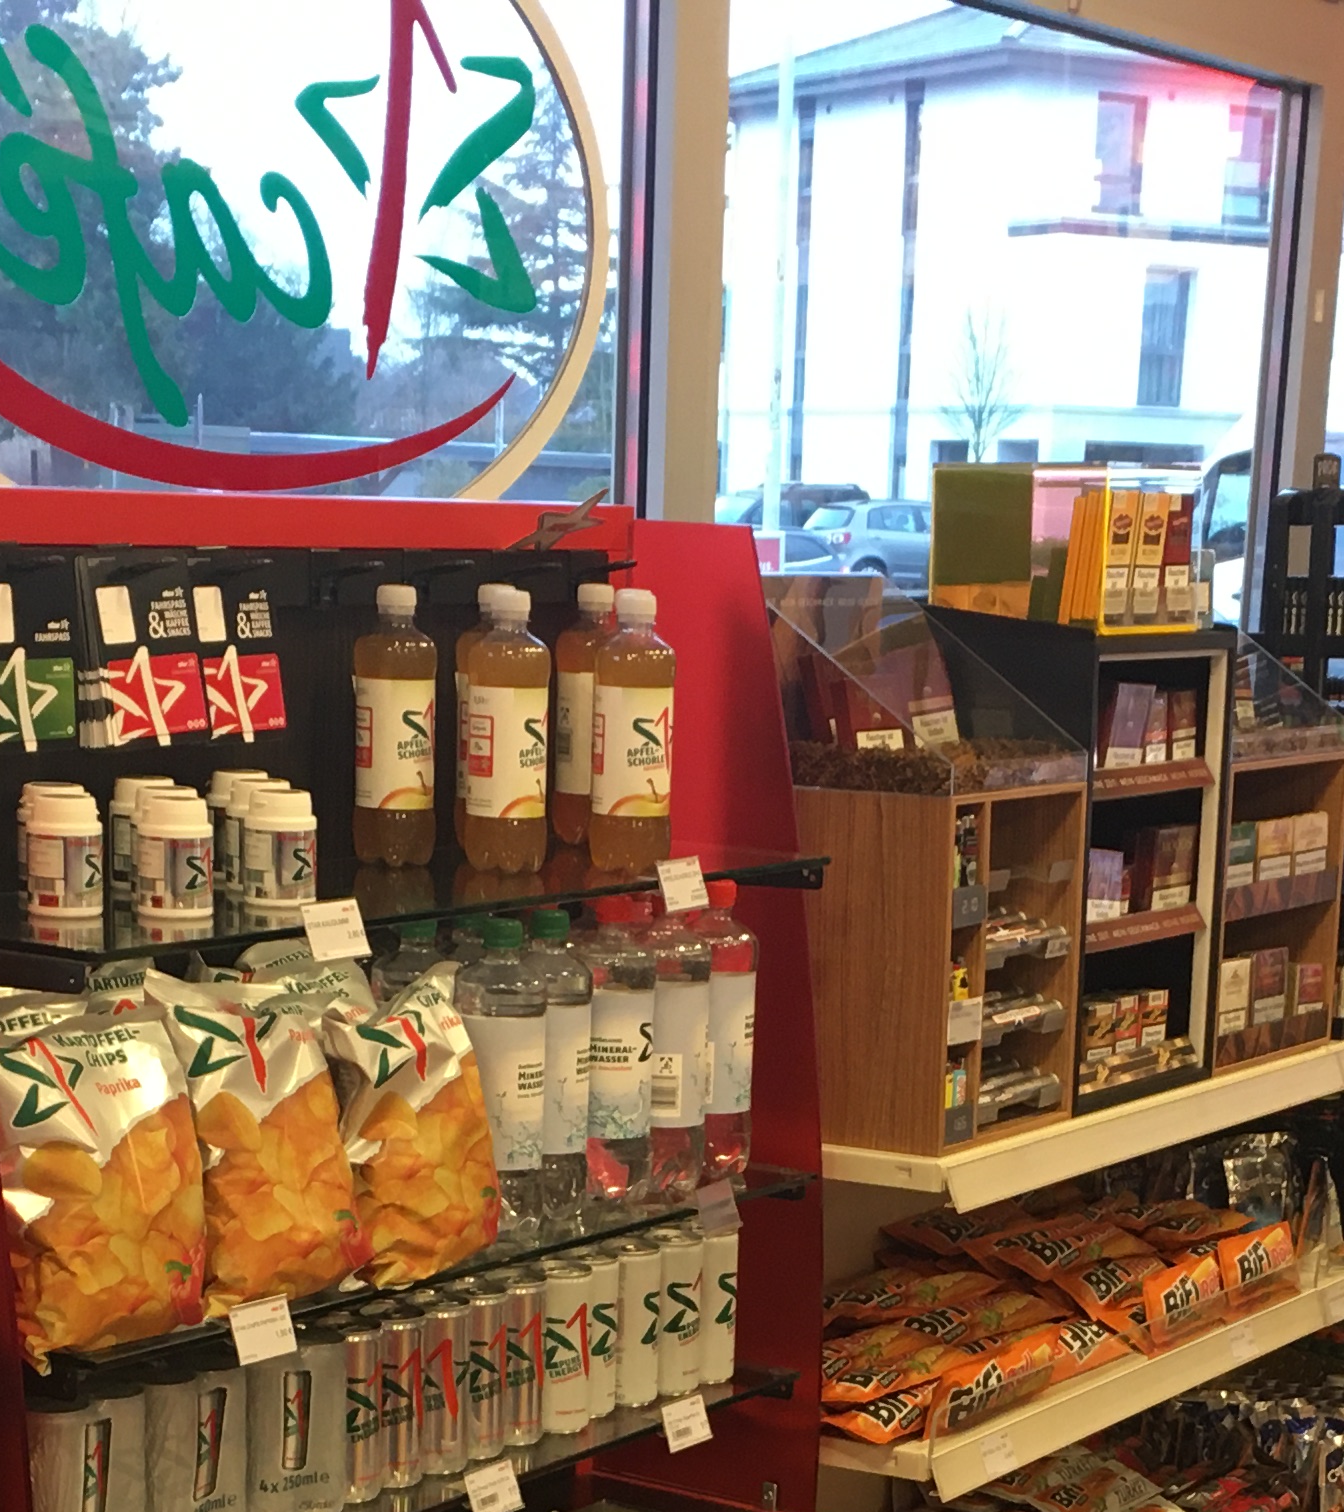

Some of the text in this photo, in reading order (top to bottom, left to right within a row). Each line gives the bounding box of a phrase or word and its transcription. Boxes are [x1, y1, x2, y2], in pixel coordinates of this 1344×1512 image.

[151, 599, 186, 611] FAHRSPASS
[148, 611, 165, 639] &
[35, 630, 70, 642] FAHRSPASS
[167, 627, 191, 637] SNACKS
[397, 740, 427, 750] APFEL-
[398, 748, 434, 760] SCHORLE
[627, 747, 660, 758] APFEL-
[627, 755, 665, 767] SCHORLE
[53, 1027, 141, 1048] KARTOFFEL-
[589, 1043, 638, 1055] MINERAL-
[85, 1049, 127, 1068] CHIPS
[589, 1053, 629, 1064] WASSER
[96, 1078, 141, 1097] Paprika
[558, 1354, 582, 1369] PURE
[549, 1363, 583, 1378] ENERGY
